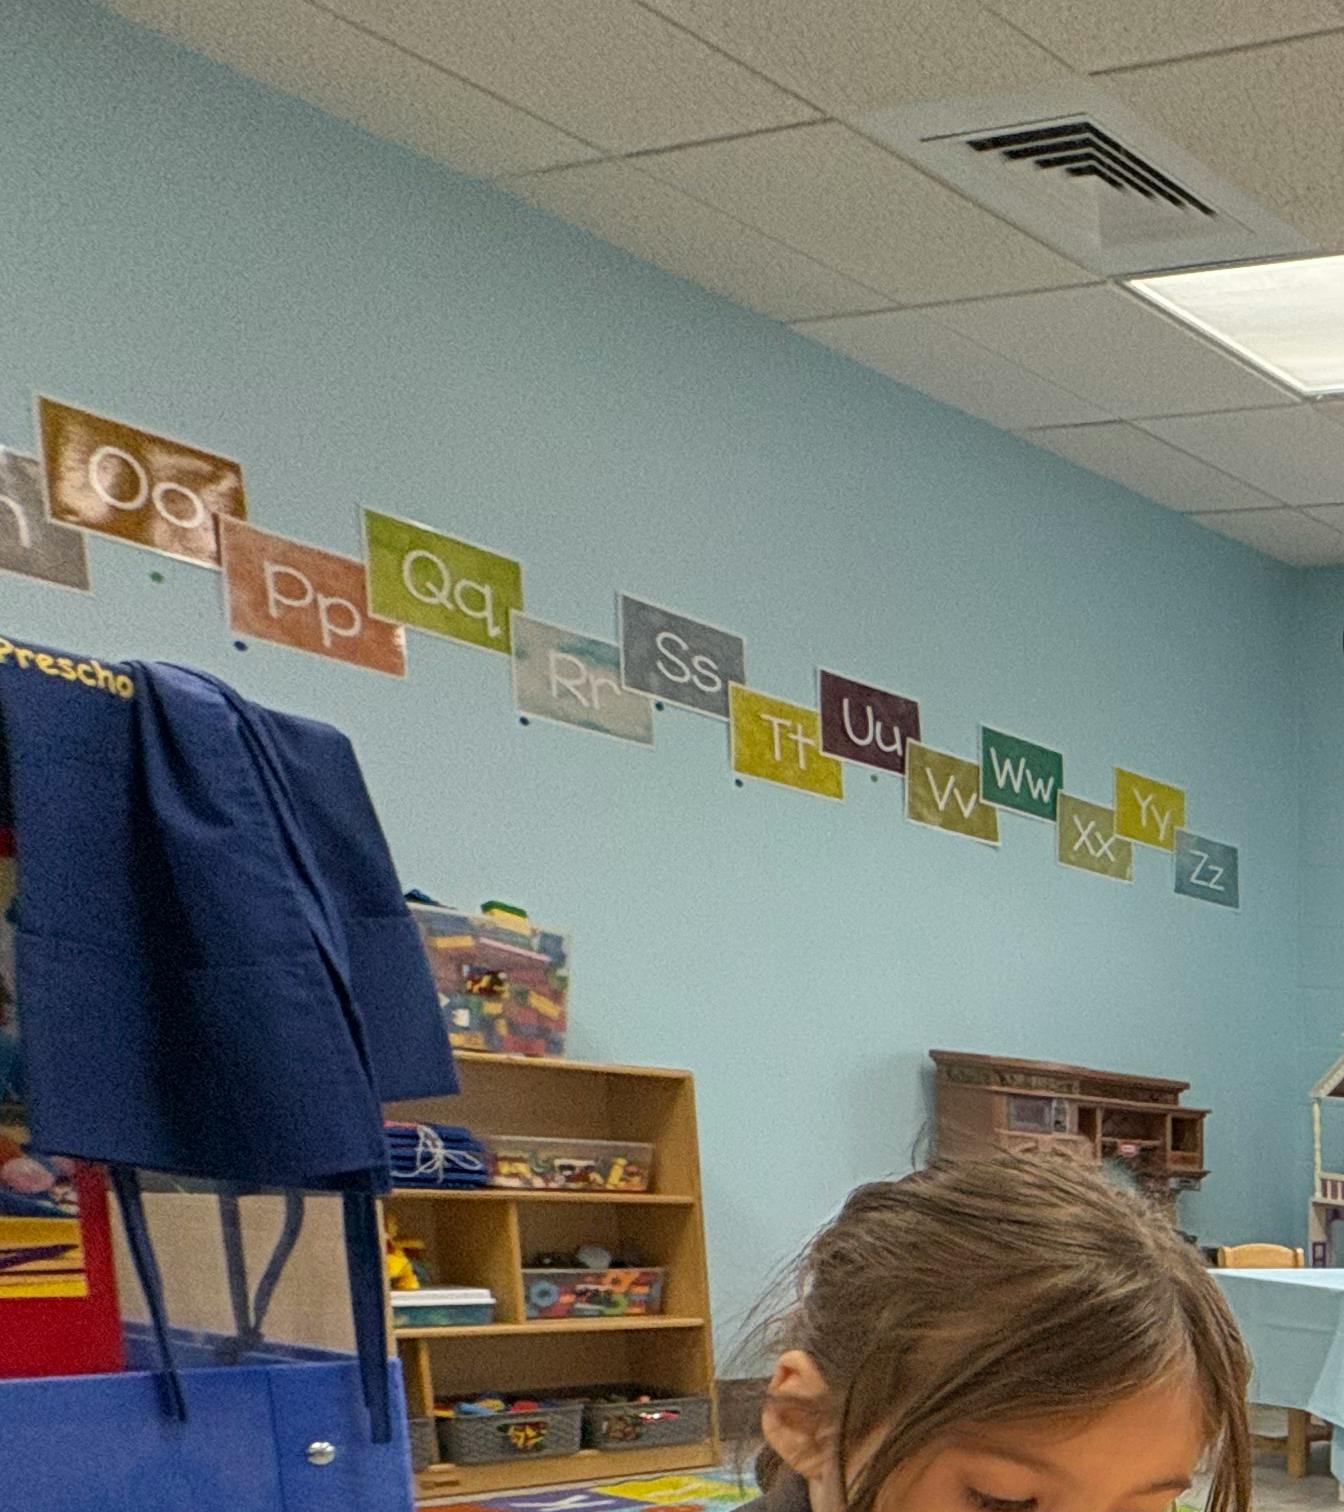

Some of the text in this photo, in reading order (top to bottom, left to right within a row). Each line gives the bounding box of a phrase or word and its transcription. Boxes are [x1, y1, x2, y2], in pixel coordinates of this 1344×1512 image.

[89, 446, 205, 528] Oo
[263, 559, 362, 649] Pp
[402, 550, 501, 638] Qq
[549, 650, 622, 710] Rr
[656, 632, 722, 692] Ss
[760, 713, 818, 770] Tt
[843, 698, 903, 756] Uu
[925, 768, 977, 818] Vv
[990, 747, 1054, 803] Ww
[1074, 814, 1116, 863] Xx
[1133, 788, 1173, 841] Yy
[1189, 851, 1225, 891] Zz
